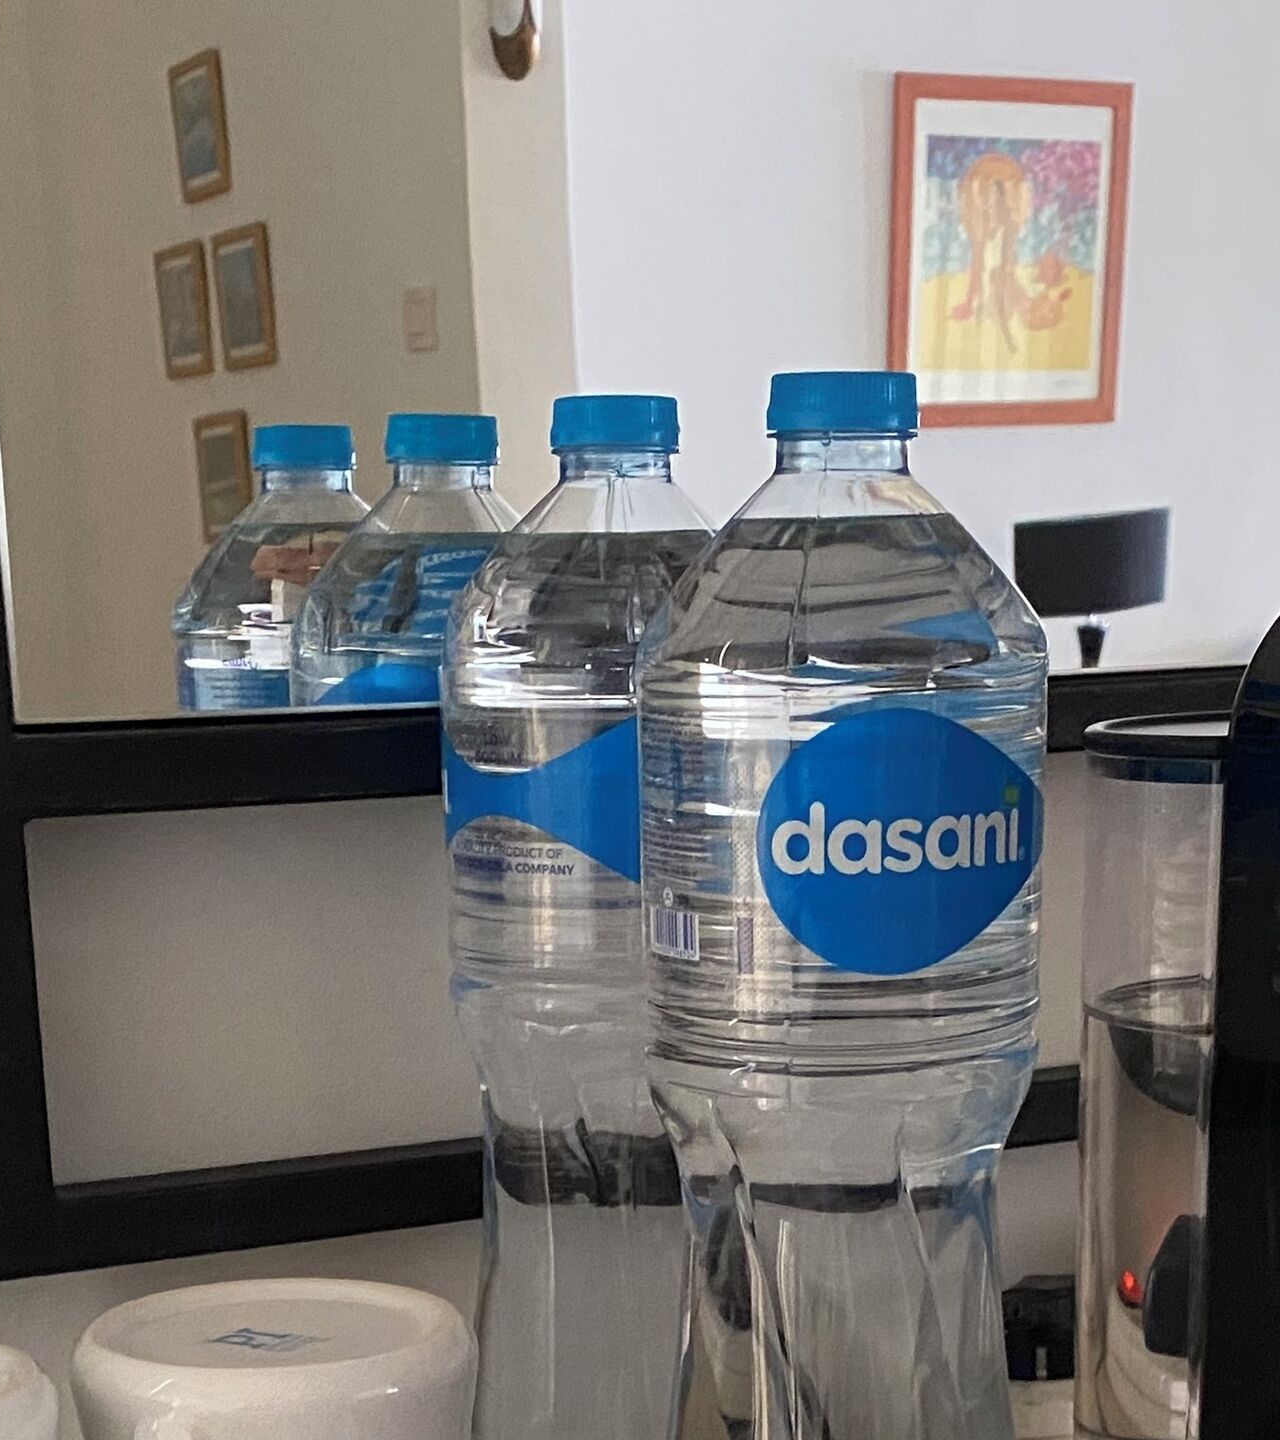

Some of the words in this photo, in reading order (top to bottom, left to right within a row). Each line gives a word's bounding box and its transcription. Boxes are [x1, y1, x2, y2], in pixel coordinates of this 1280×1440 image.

[771, 792, 1019, 876] dasani
[545, 848, 563, 858] OF
[515, 862, 575, 876] COMPANY
